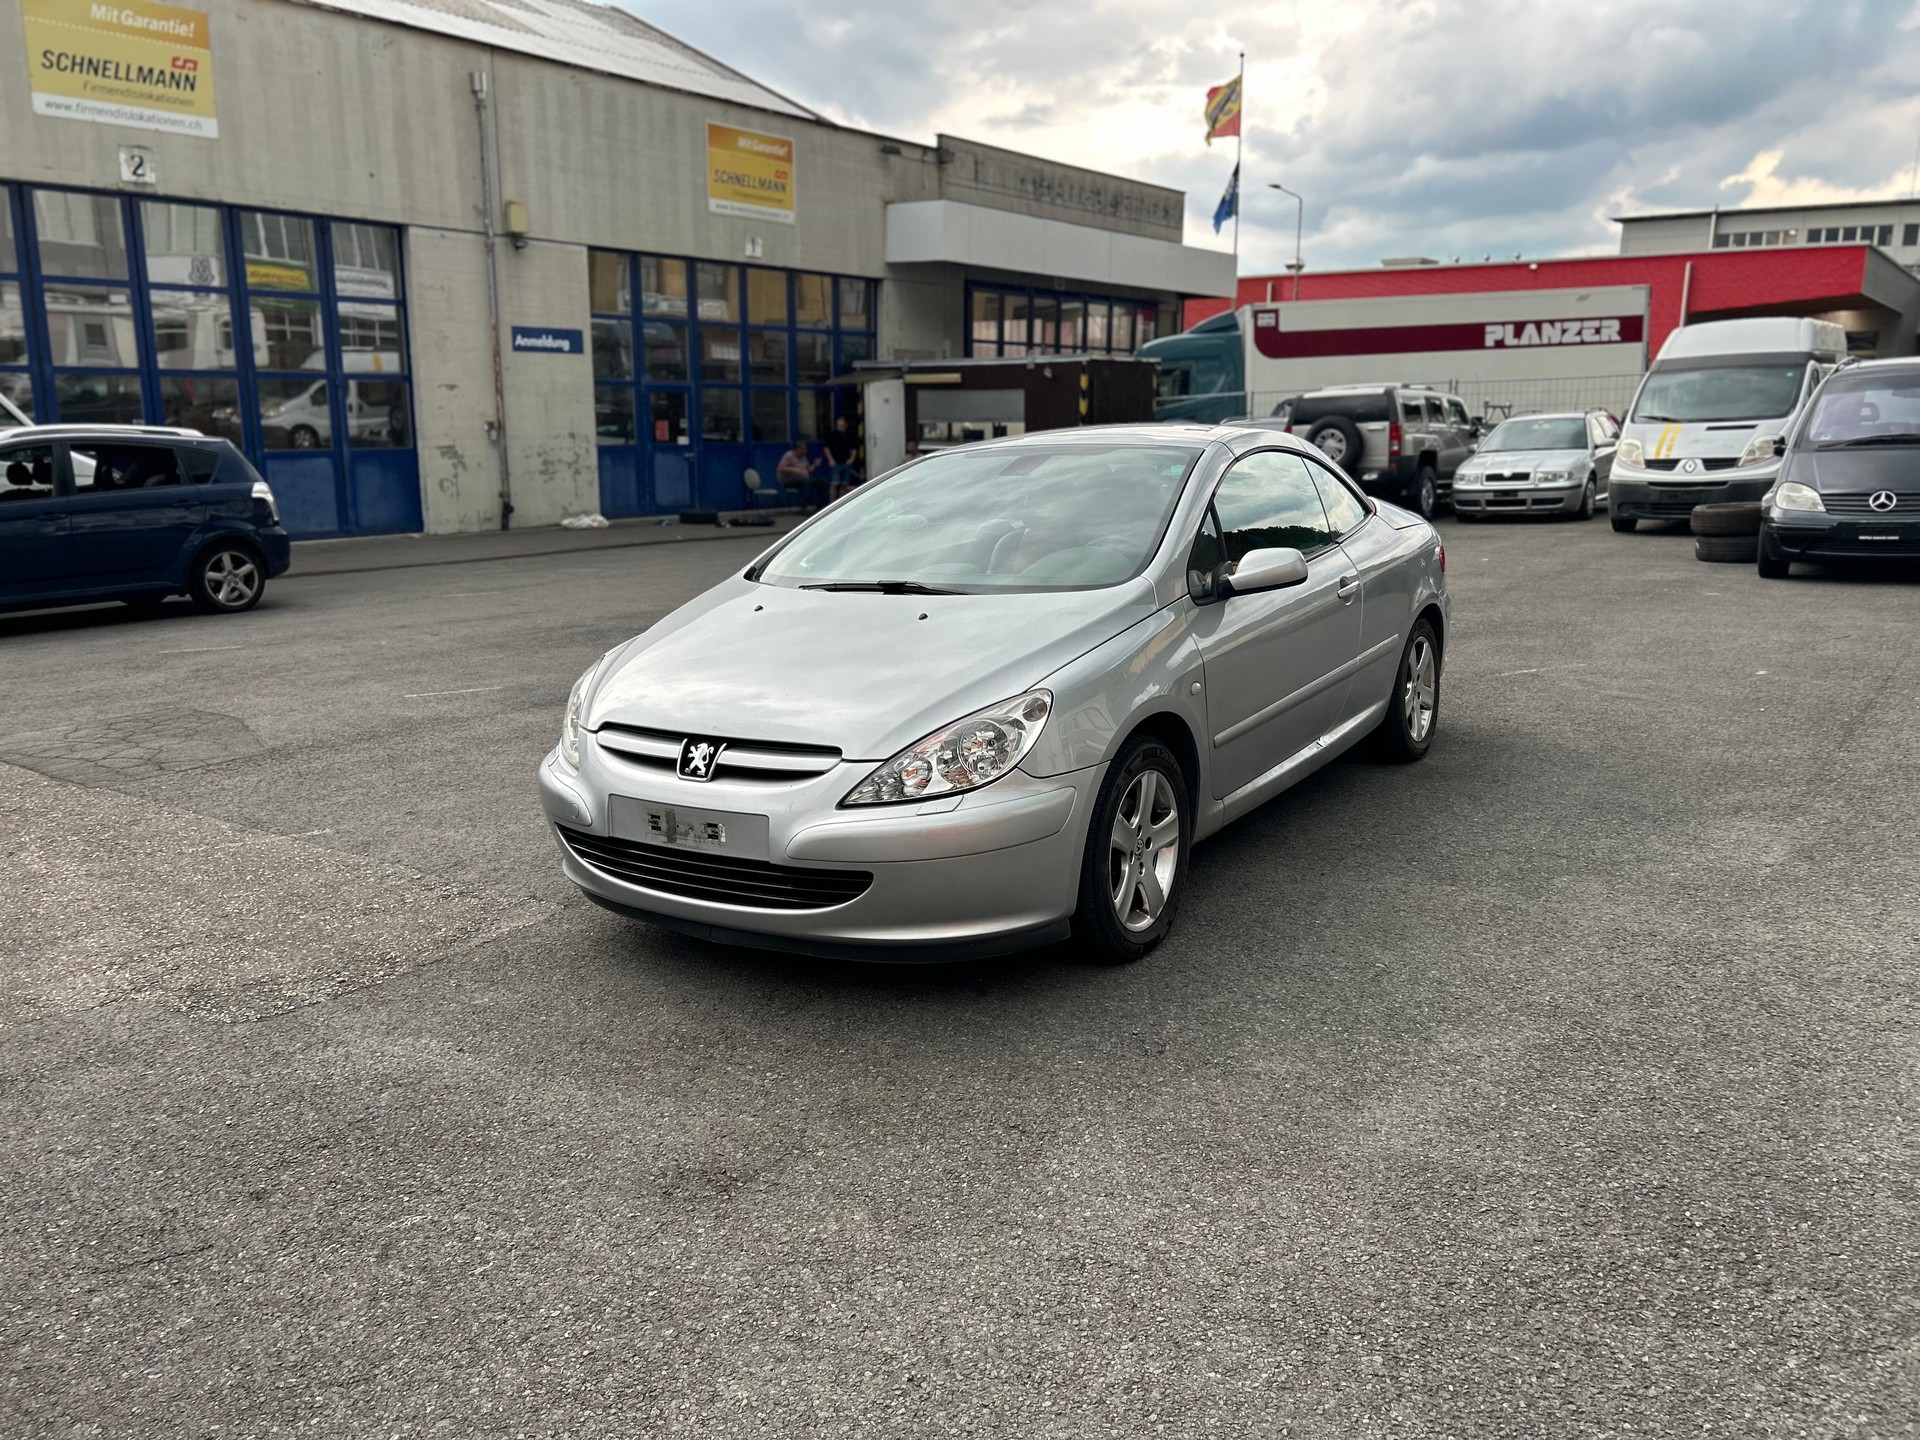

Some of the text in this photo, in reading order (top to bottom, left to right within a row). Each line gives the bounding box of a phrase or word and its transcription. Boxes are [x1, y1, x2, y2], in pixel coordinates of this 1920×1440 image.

[90, 4, 195, 38] Mit Garantie!
[41, 50, 197, 92] SCHNELLMANN
[83, 81, 194, 107] Firmendislokationen
[44, 100, 203, 131] www.firmendislokationen.ch
[130, 154, 145, 177] 2
[713, 169, 787, 194] SCHNELLMANN
[1484, 318, 1622, 348] PLANZER
